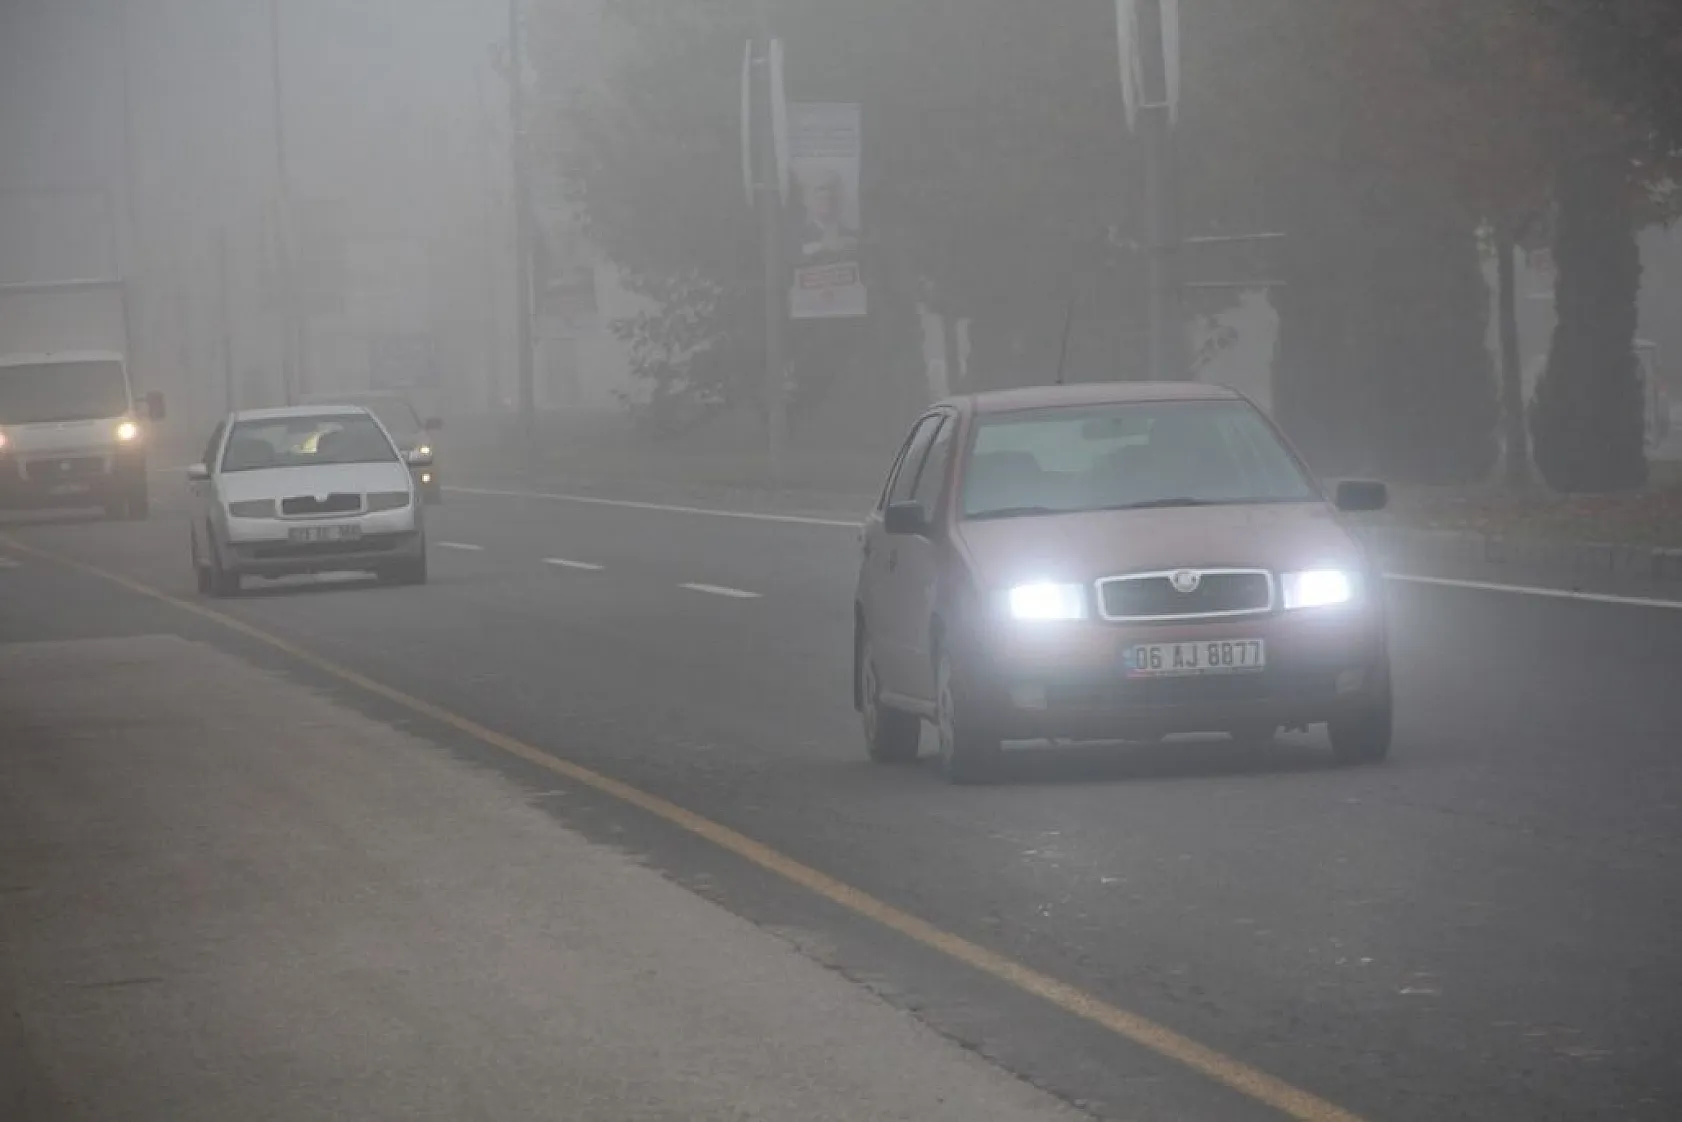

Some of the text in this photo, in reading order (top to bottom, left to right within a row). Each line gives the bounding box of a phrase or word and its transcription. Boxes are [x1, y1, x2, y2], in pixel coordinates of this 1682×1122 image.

[1136, 642, 1260, 670] 06 AJ 8877
